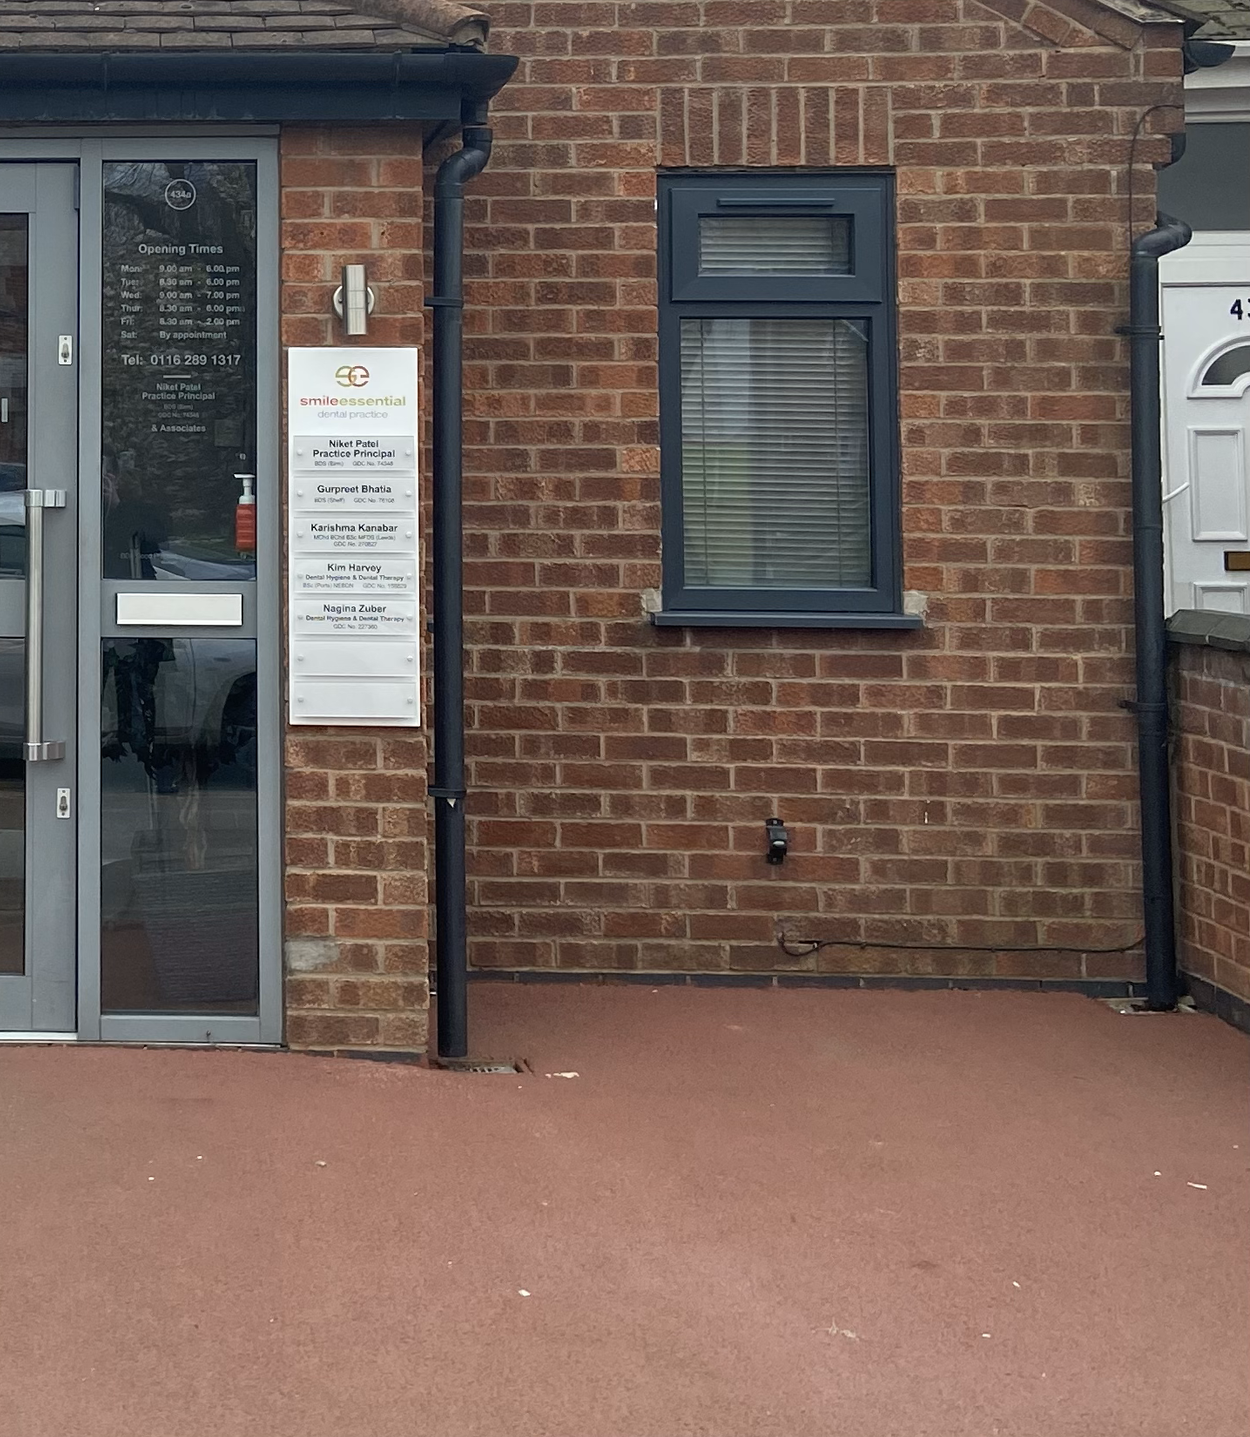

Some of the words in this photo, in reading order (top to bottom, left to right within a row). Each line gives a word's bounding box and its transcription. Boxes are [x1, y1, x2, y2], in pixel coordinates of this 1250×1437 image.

[138, 244, 186, 255] Opening
[189, 244, 223, 253] Times
[1230, 298, 1250, 320] 4
[226, 319, 240, 327] pm
[121, 331, 138, 339] Sat:
[160, 331, 171, 340] By
[173, 331, 227, 340] appointment
[122, 355, 143, 365] Tel:
[150, 355, 181, 365] 0116
[184, 355, 207, 365] 289
[211, 355, 241, 365] 1317
[156, 383, 178, 391] Niket
[180, 383, 201, 391] Patel
[178, 392, 215, 401] Principal
[300, 395, 406, 406] smileessential
[318, 410, 347, 418] dental
[349, 411, 388, 419] practice
[329, 440, 353, 448] Niket
[356, 440, 379, 448] Patel
[354, 450, 396, 459] Principal
[317, 485, 359, 494] Gurpreet
[361, 485, 392, 493] Bhatia
[311, 524, 355, 532] Karishma
[358, 524, 398, 532] Kanabar
[349, 564, 381, 573] Harvey
[323, 605, 356, 614] Nagina
[359, 605, 387, 613] Zuber
